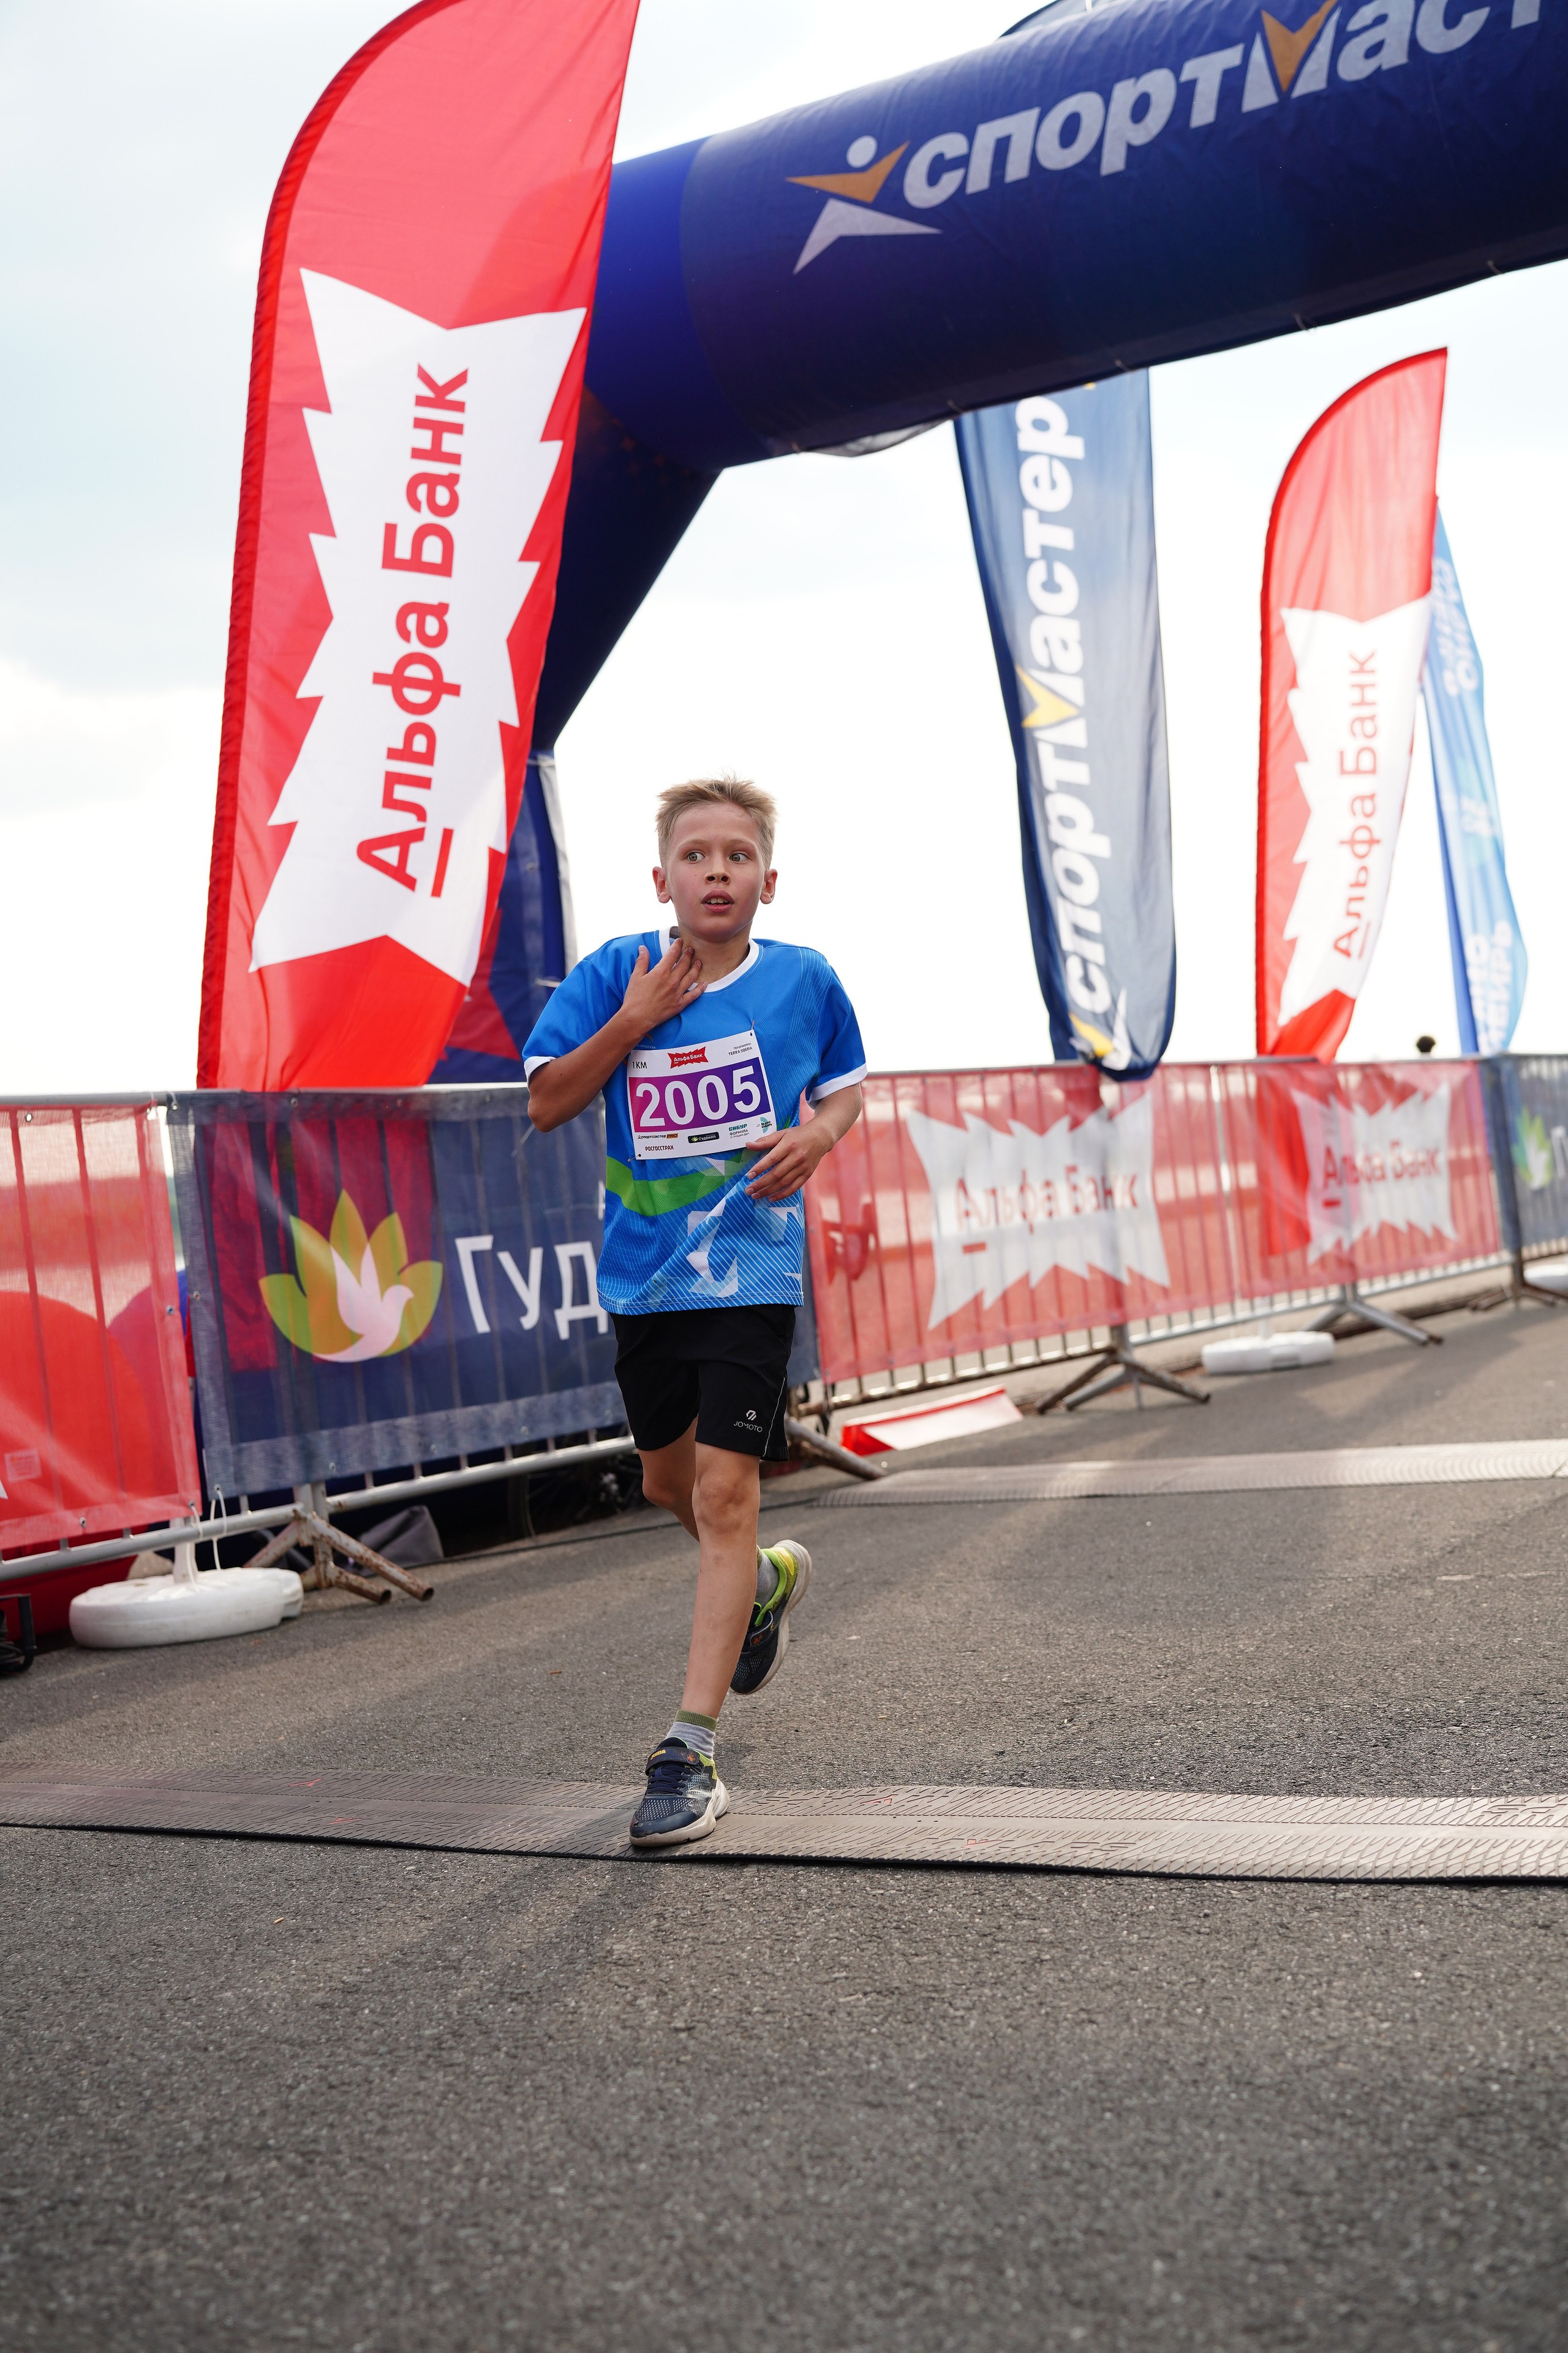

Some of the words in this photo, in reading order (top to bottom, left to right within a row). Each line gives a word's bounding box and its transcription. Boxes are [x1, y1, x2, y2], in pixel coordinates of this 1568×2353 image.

[382, 363, 469, 578] Банк
[356, 602, 462, 897] Альфа
[1015, 395, 1112, 1014] спортМастер
[1339, 649, 1378, 776] Банк
[1333, 792, 1381, 959] Альфа
[636, 1065, 761, 1127] 2005
[674, 1056, 690, 1064] Альфа
[956, 1168, 1058, 1254] Альфа
[1065, 1164, 1139, 1214] Банк
